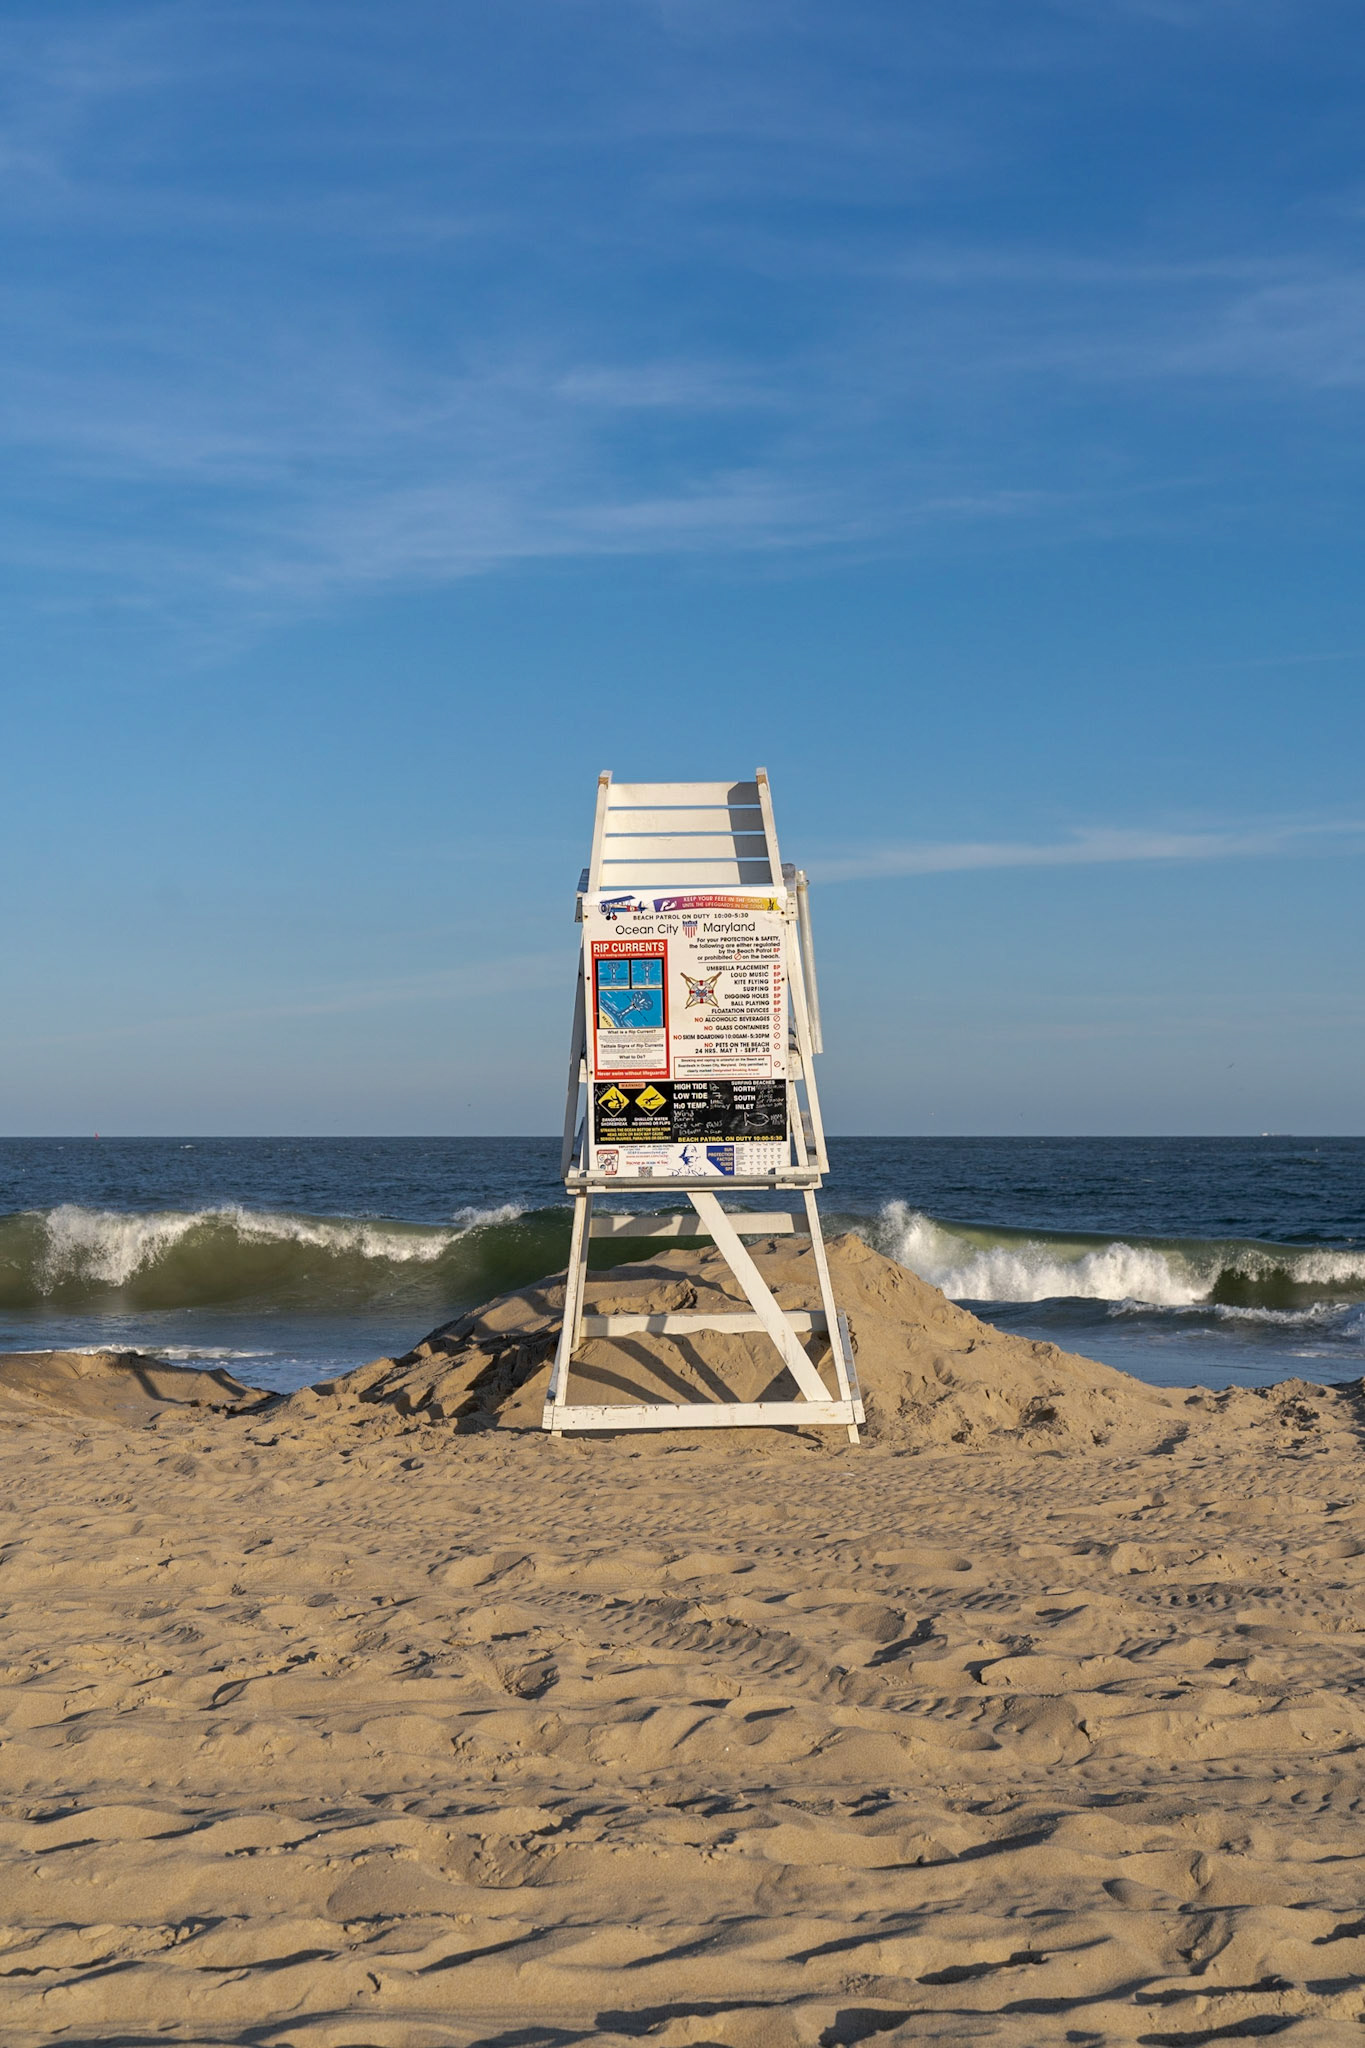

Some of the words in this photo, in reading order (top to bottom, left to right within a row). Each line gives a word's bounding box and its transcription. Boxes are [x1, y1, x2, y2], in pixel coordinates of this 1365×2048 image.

[616, 925, 654, 935] Ocean
[658, 924, 679, 935] City
[703, 922, 756, 934] Maryland
[593, 944, 609, 953] RIP
[611, 942, 664, 952] CURRENTS
